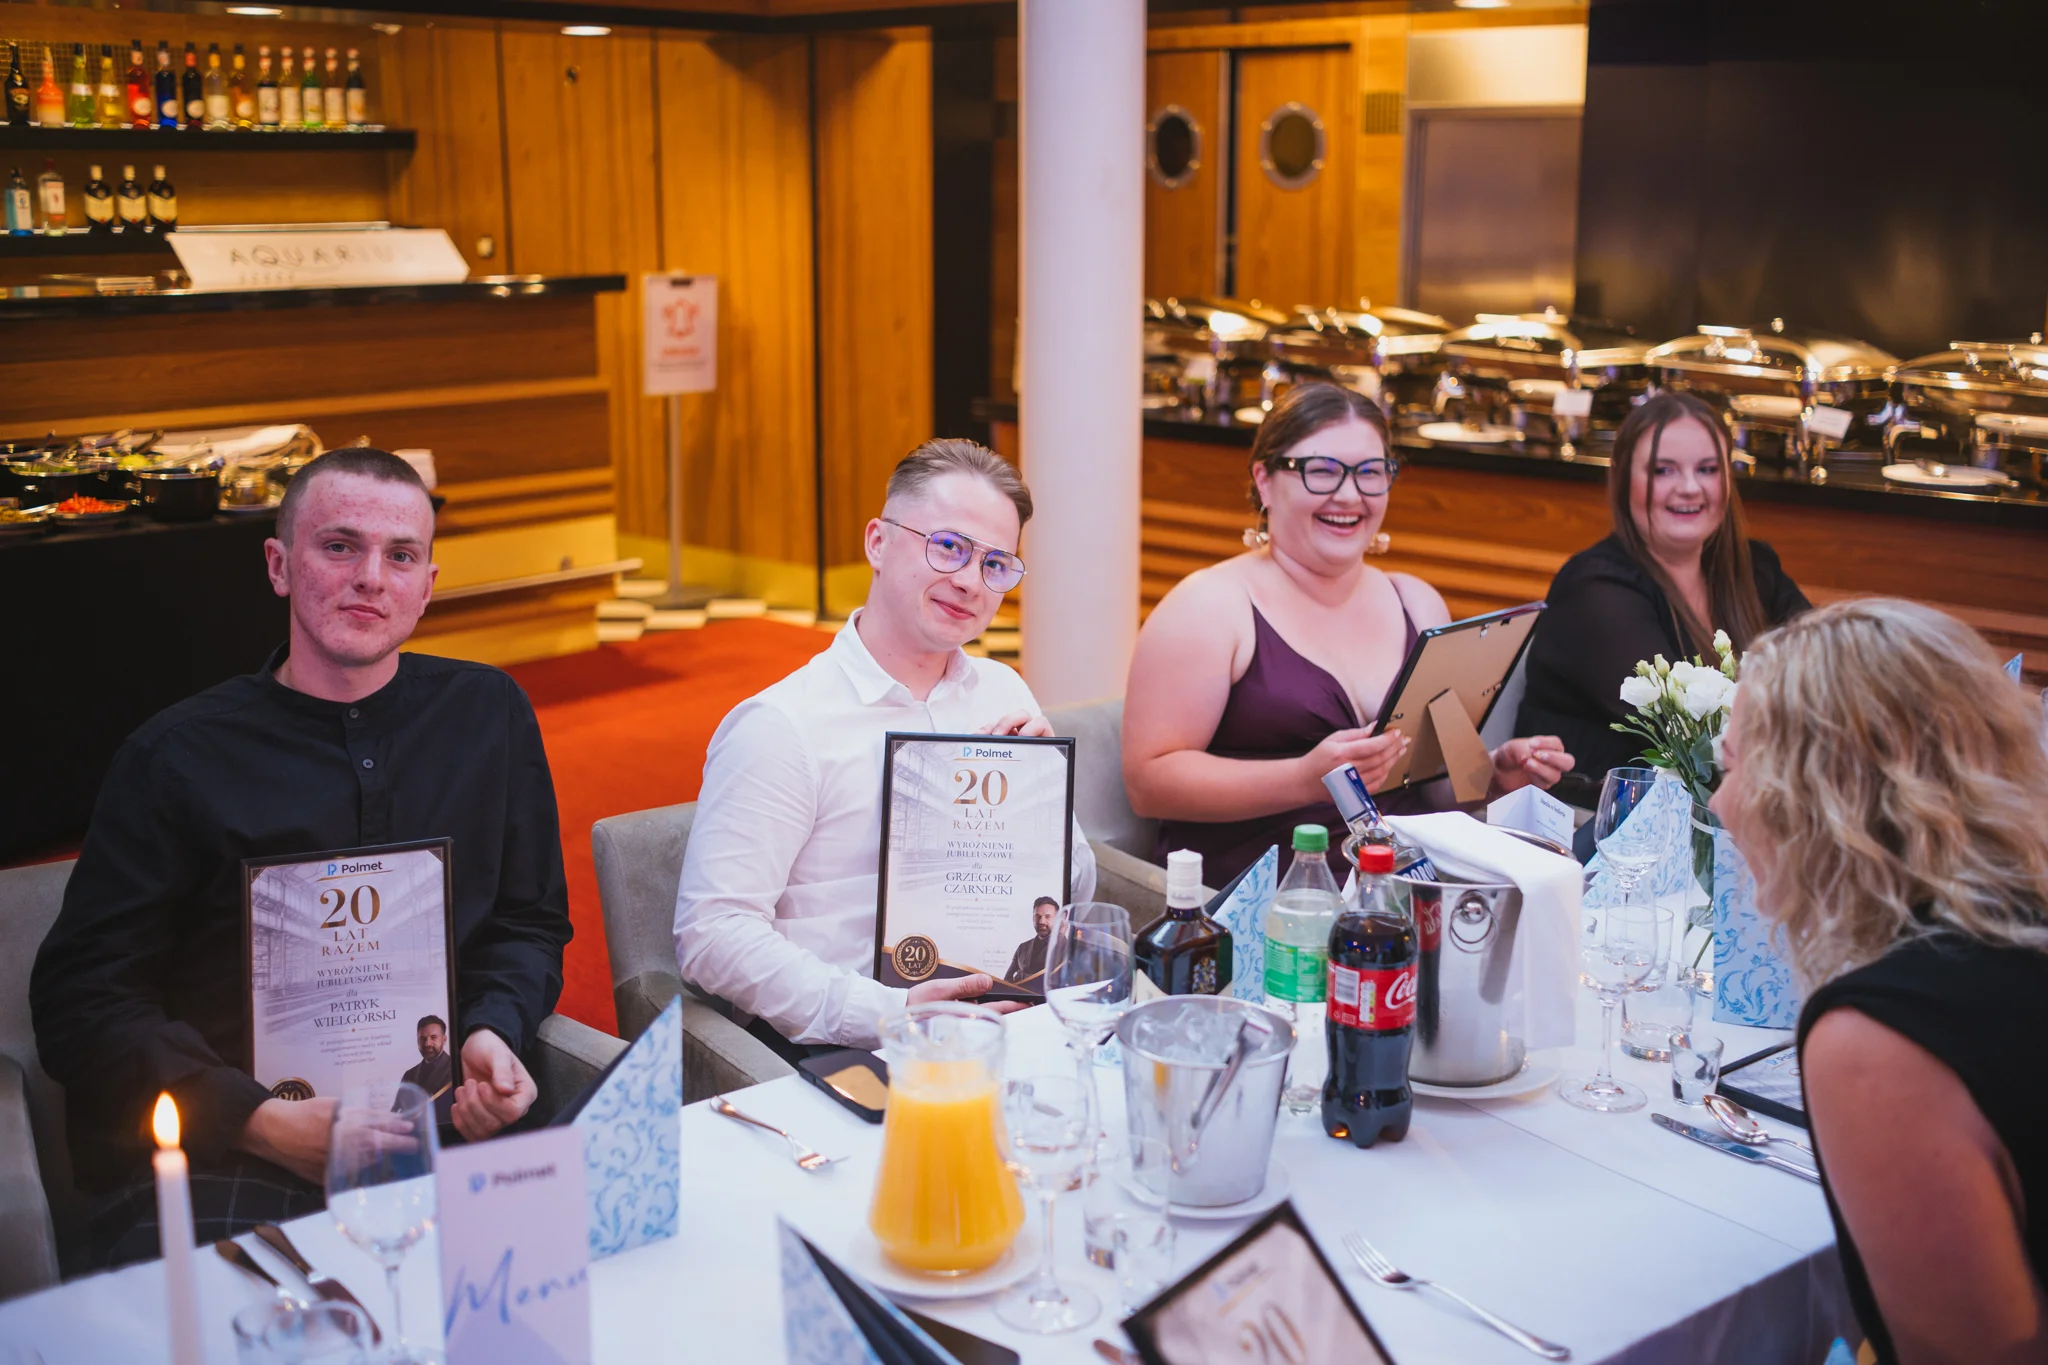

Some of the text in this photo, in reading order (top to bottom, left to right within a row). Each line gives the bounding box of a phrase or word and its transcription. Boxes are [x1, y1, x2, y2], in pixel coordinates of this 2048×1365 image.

[975, 748, 1013, 759] Polmet
[953, 769, 1008, 806] 20
[965, 808, 996, 819] LAT
[953, 820, 1005, 831] RAZEM
[946, 850, 1015, 859] JUBILEUSZOWE
[341, 861, 383, 874] Polmet
[945, 872, 1013, 883] GRZEGORZ
[944, 884, 1013, 896] CZARNECKI
[320, 885, 381, 929] 20
[334, 928, 369, 942] LAT
[322, 941, 379, 956] RAZEM
[904, 945, 927, 961] 20
[316, 972, 392, 990] JUBILEUSZOWE
[346, 988, 358, 998] dla
[330, 998, 380, 1013] PATRYK
[313, 1009, 397, 1029] WIELGÓRSKI
